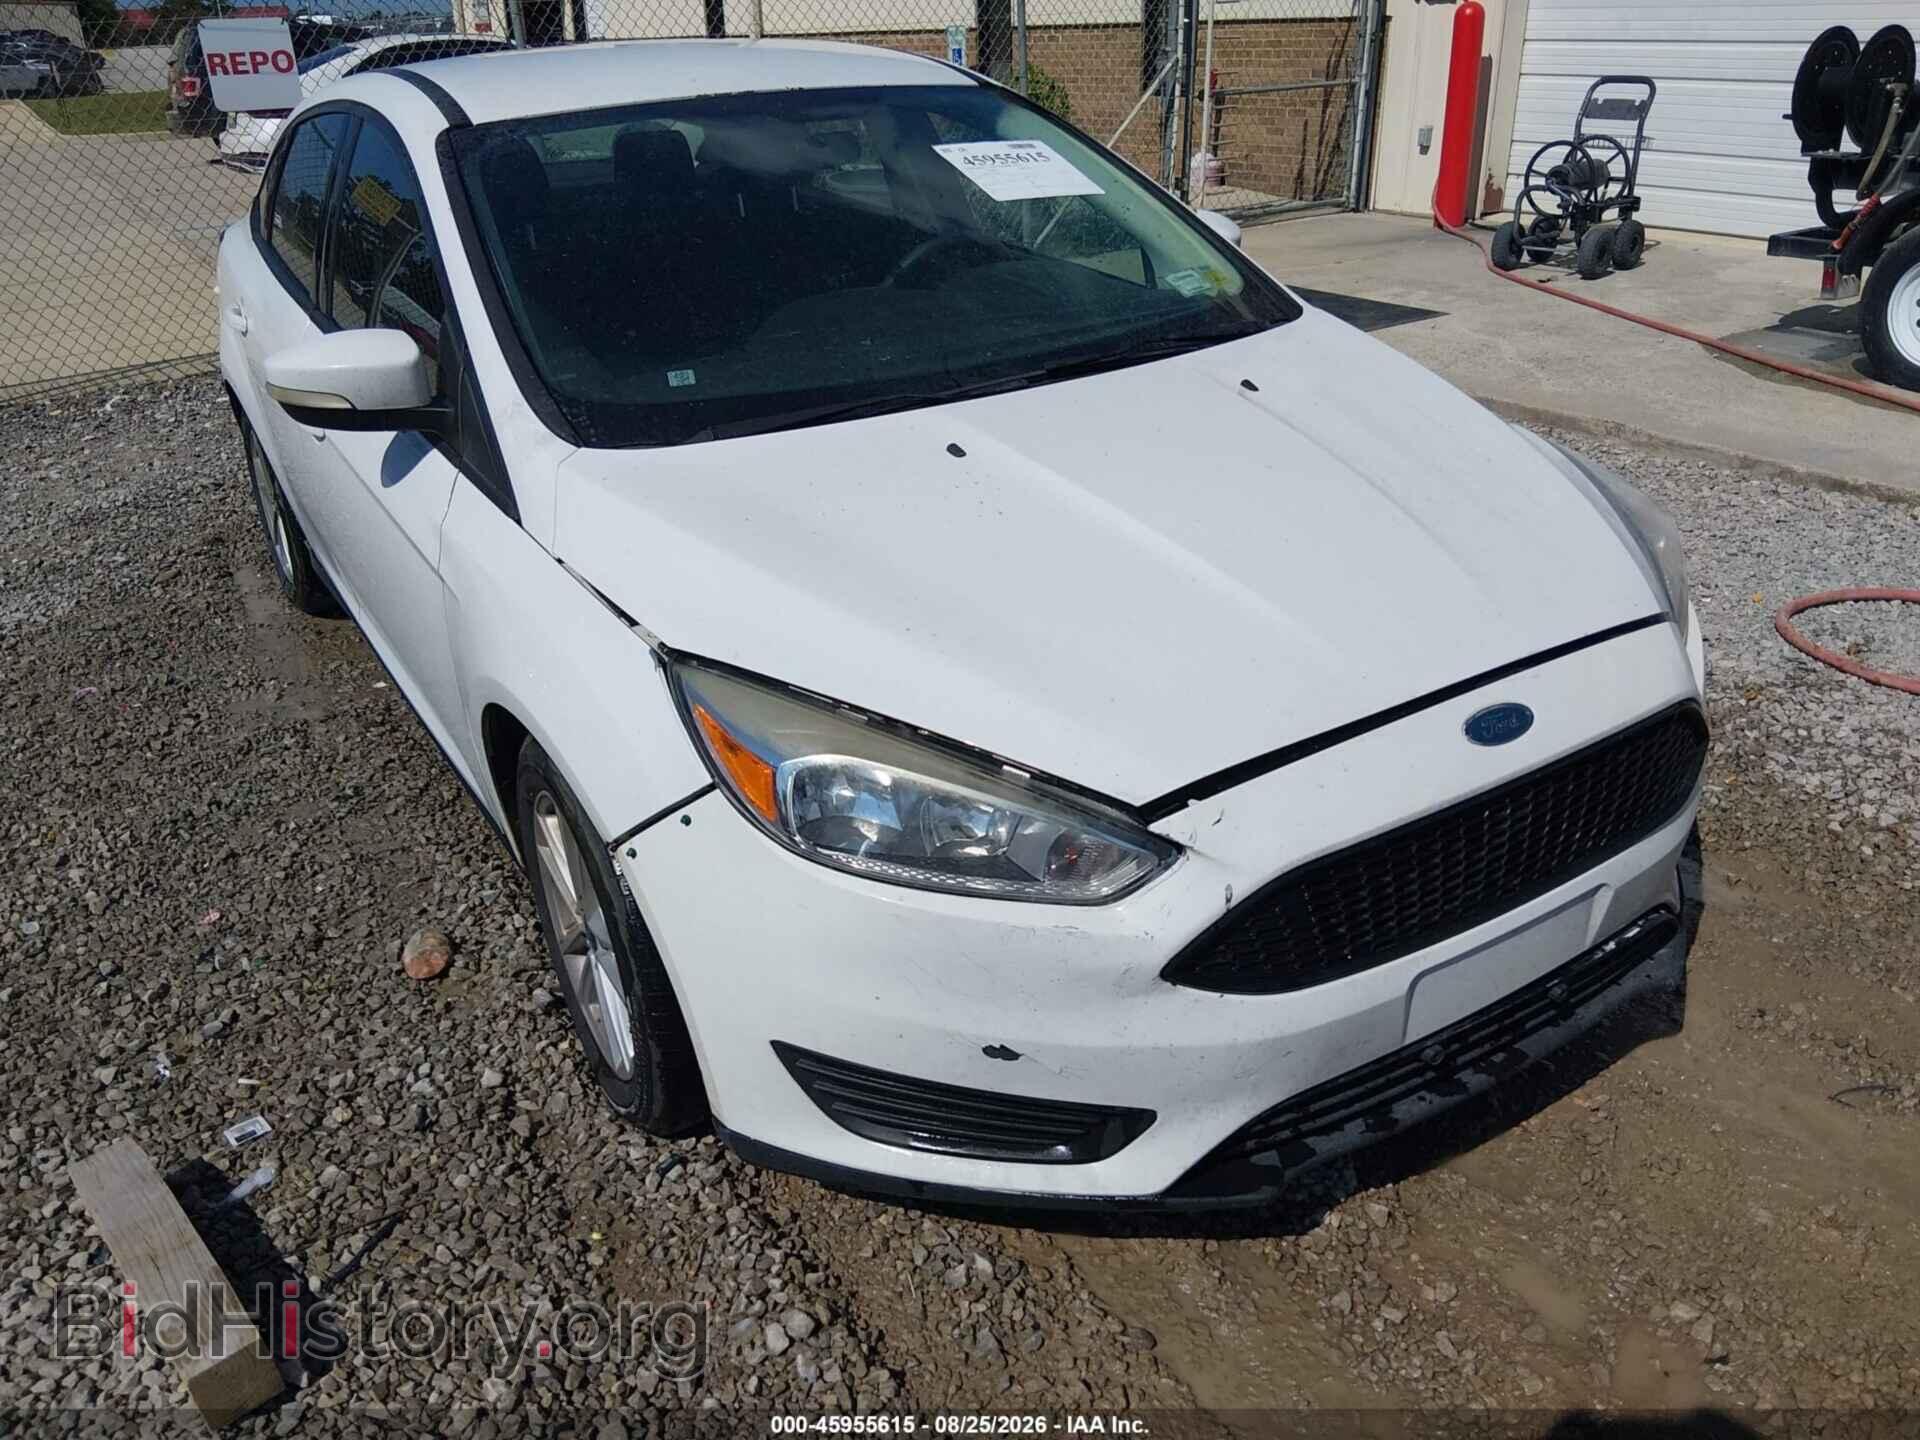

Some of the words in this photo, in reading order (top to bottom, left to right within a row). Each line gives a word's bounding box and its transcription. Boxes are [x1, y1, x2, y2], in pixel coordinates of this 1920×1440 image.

[206, 49, 295, 76] REPO
[962, 152, 1051, 166] 45955615
[1478, 711, 1520, 738] Ford
